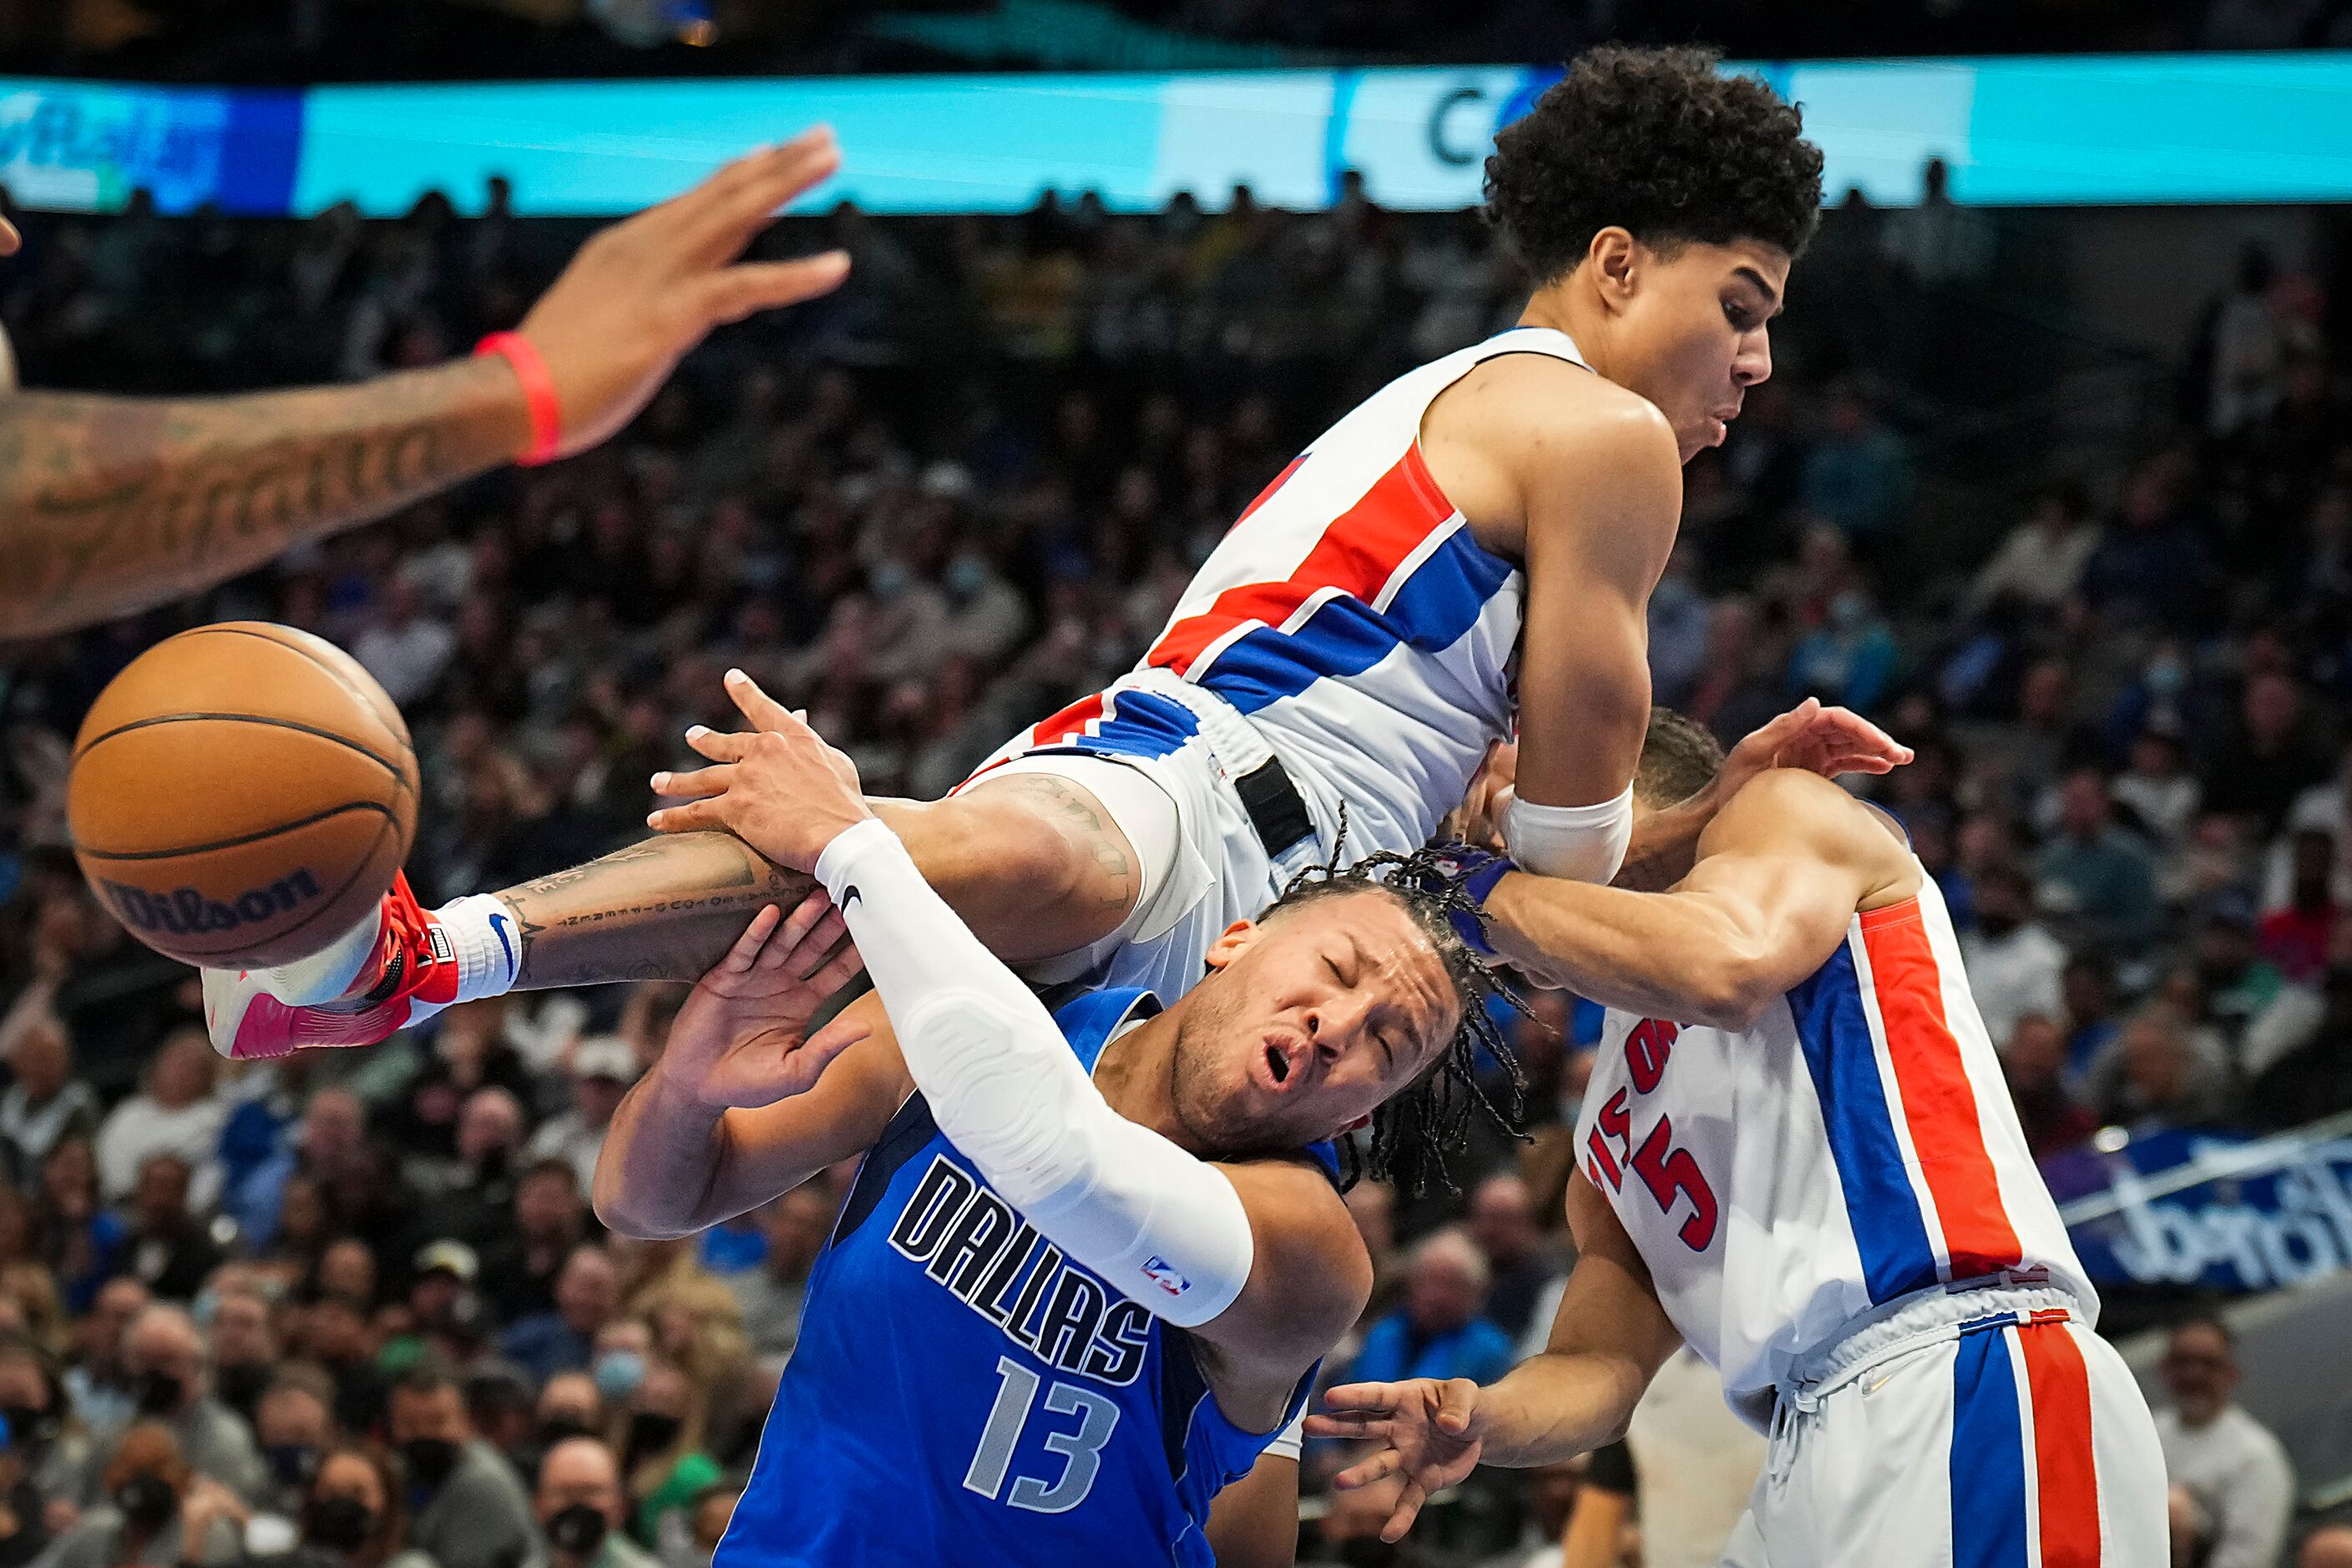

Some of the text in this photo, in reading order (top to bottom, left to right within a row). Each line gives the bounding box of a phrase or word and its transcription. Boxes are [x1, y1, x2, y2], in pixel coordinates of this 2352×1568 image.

[99, 867, 321, 936] Wilson
[431, 928, 450, 958] PUMA
[1630, 1112, 1717, 1253] 5
[888, 1152, 1154, 1387] DALLAS
[962, 1354, 1120, 1514] 13
